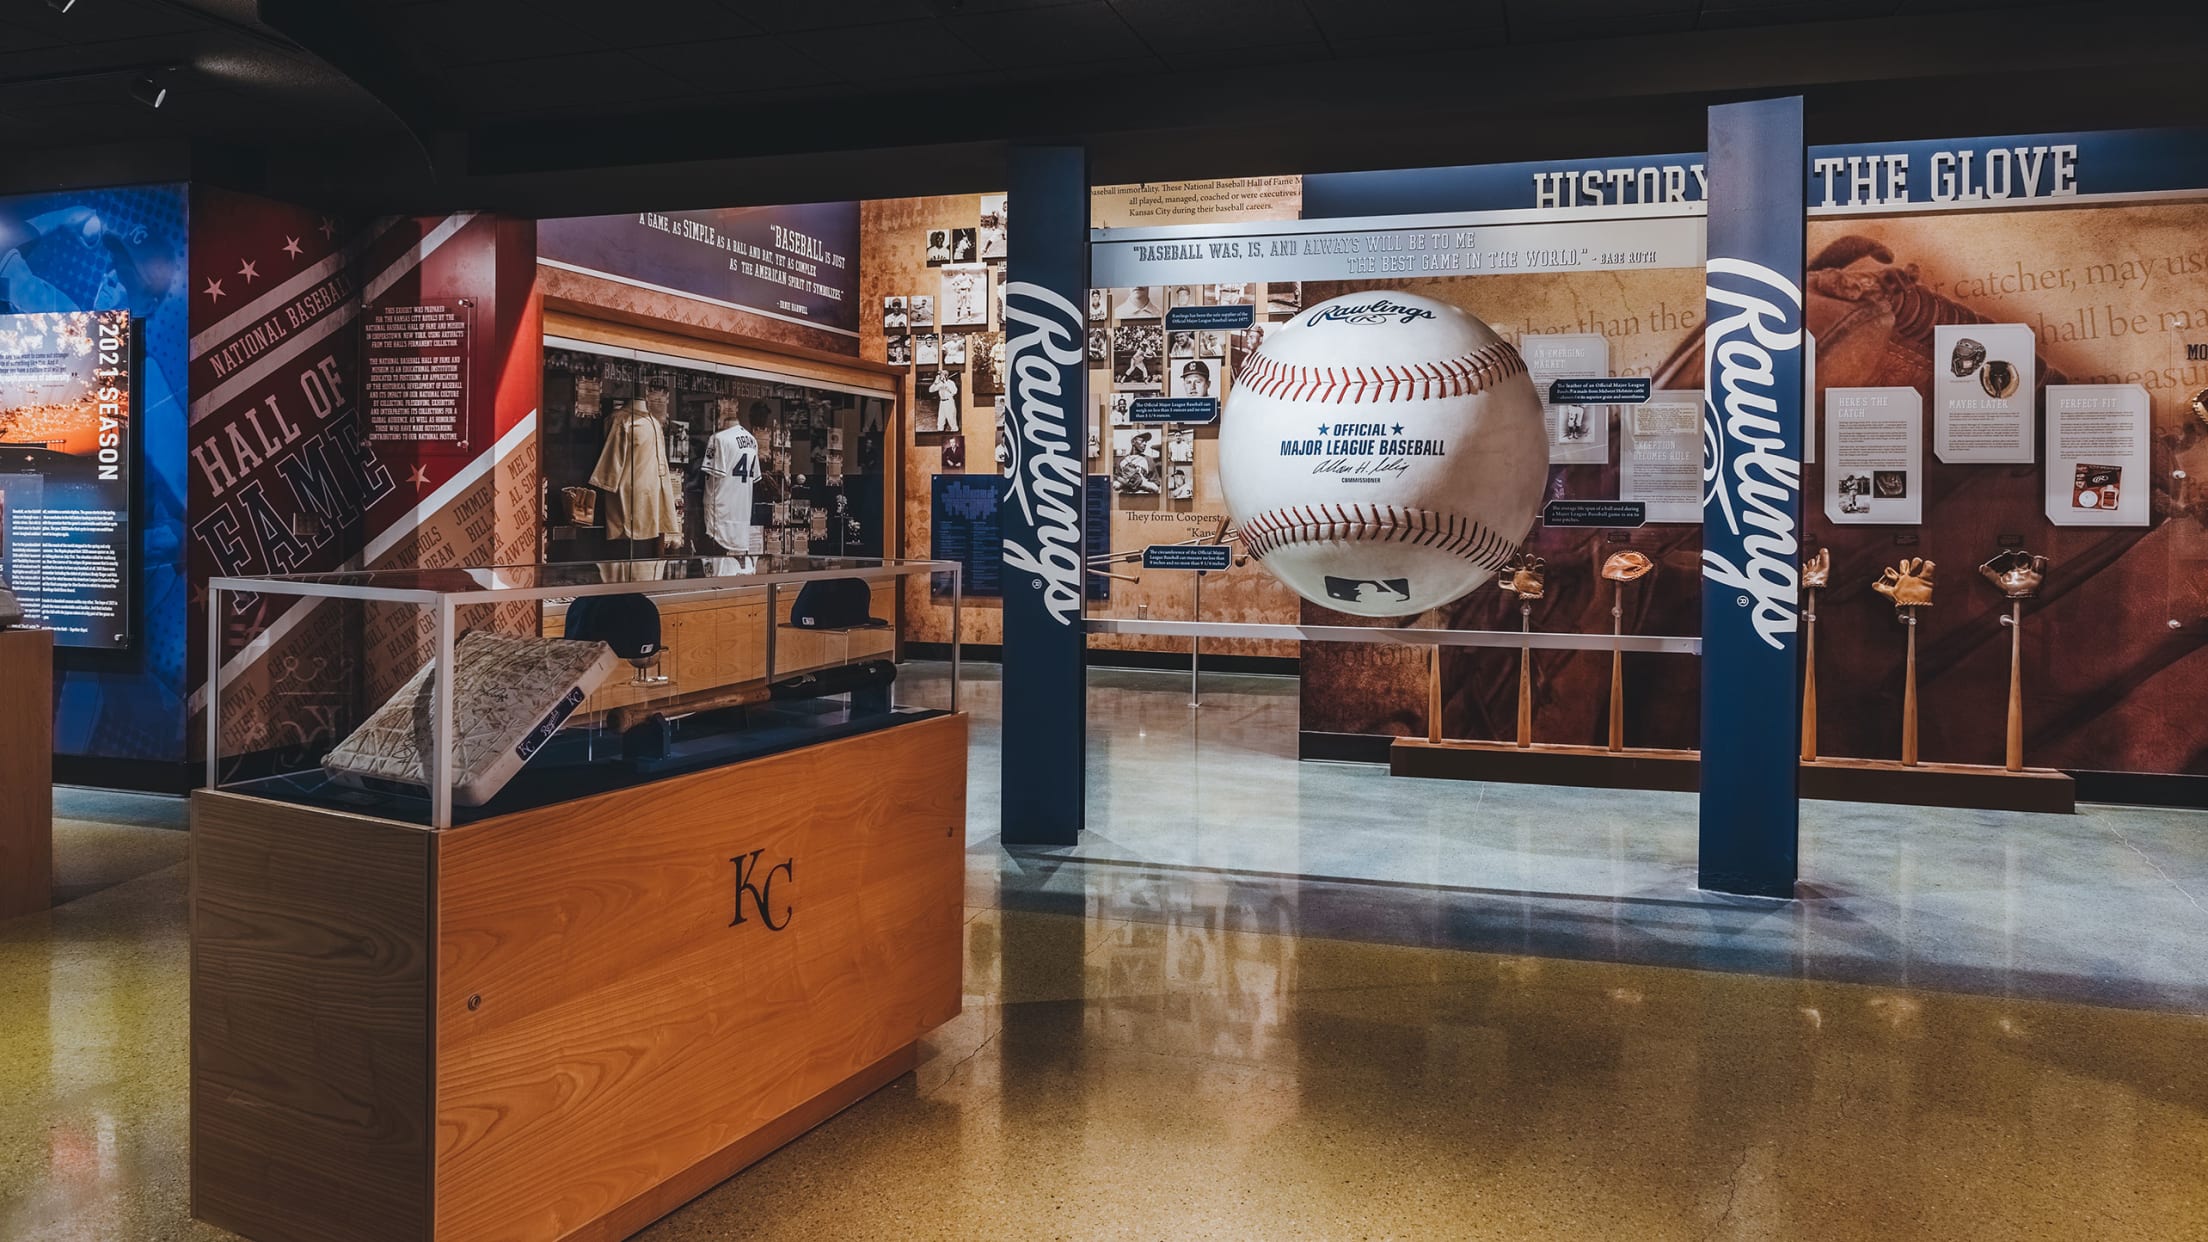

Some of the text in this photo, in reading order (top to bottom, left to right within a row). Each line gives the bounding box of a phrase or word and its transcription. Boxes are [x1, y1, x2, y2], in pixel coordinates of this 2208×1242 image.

[1118, 184, 1160, 195] immortality.
[1162, 184, 1182, 192] These
[1184, 182, 1214, 191] National
[1216, 180, 1245, 189] Baseball
[1264, 178, 1272, 186] of
[1533, 144, 2078, 208] HISTORY THE GLOVE
[1129, 197, 1138, 205] all
[1139, 196, 1163, 206] played,
[1165, 195, 1198, 204] managed,
[1200, 192, 1229, 201] coached
[1260, 190, 1296, 198] executives
[1129, 208, 1154, 217] Kansas
[1155, 207, 1171, 217] City
[1172, 206, 1195, 216] during
[1197, 205, 1214, 213] their
[1216, 203, 1244, 212] baseball
[639, 213, 817, 277] A GAME, AS SIMPLE AS A BALL AND BAT, YET AS COMPLEX
[1209, 242, 1242, 259] WAS,
[1248, 241, 1264, 258] IS,
[1270, 240, 1297, 256] AND
[1303, 237, 1360, 255] ALWAYS
[1366, 235, 1402, 252] WILL
[1408, 234, 1425, 250] BE
[1432, 233, 1449, 249] TO
[1455, 232, 1475, 249] ME
[825, 251, 830, 265] IS
[832, 254, 845, 270] JUST
[1347, 257, 1376, 274] THE
[1381, 255, 1415, 272] BEST
[1421, 253, 1460, 271] GAME
[1466, 252, 1482, 269] IN
[1488, 251, 1518, 268] THE
[1600, 253, 1625, 265] BABE
[1628, 251, 1657, 263] RUTH
[729, 258, 737, 271] AS
[741, 261, 753, 276] THE
[754, 264, 787, 285] AMERICAN
[788, 275, 805, 291] SPIRIT
[805, 281, 811, 292] IT
[1954, 251, 2208, 299] catcher, may us
[1307, 300, 1437, 327] Rawlings
[1579, 309, 1643, 337] than
[1650, 301, 1695, 331] the
[2037, 307, 2100, 345] hall
[2105, 305, 2149, 337] be
[209, 317, 288, 378] NATIONAL
[1534, 348, 1584, 358] AN EMERGING
[1534, 360, 1564, 369] MARKET
[98, 324, 119, 480] 2021 SEASON
[1839, 408, 1864, 417] CATCH
[1872, 397, 1888, 406] THE
[1949, 399, 2008, 408] MAYBE LATER
[2060, 399, 2117, 408] PERFECT FIT
[191, 355, 345, 497] HALL OF
[1334, 424, 1387, 436] OFFICIAL
[1003, 281, 1083, 626] Rawlings
[1280, 440, 1445, 456] MAJOR LEAGUE BASEBALL
[1703, 258, 1802, 650] Rawlings
[507, 454, 527, 480] MEL
[454, 487, 491, 526] JIMMIE
[509, 486, 522, 507] AL
[192, 408, 396, 615] FAME
[513, 505, 530, 530] JOE
[1127, 511, 1223, 524] They form Cooperst
[465, 516, 492, 544] BILL
[424, 542, 456, 569] DEAN
[387, 628, 420, 659] HANK
[391, 638, 436, 680] MCKECHN
[566, 691, 582, 706] KC
[540, 710, 559, 737] Royals
[518, 741, 536, 756] KC
[729, 849, 794, 932] KC
